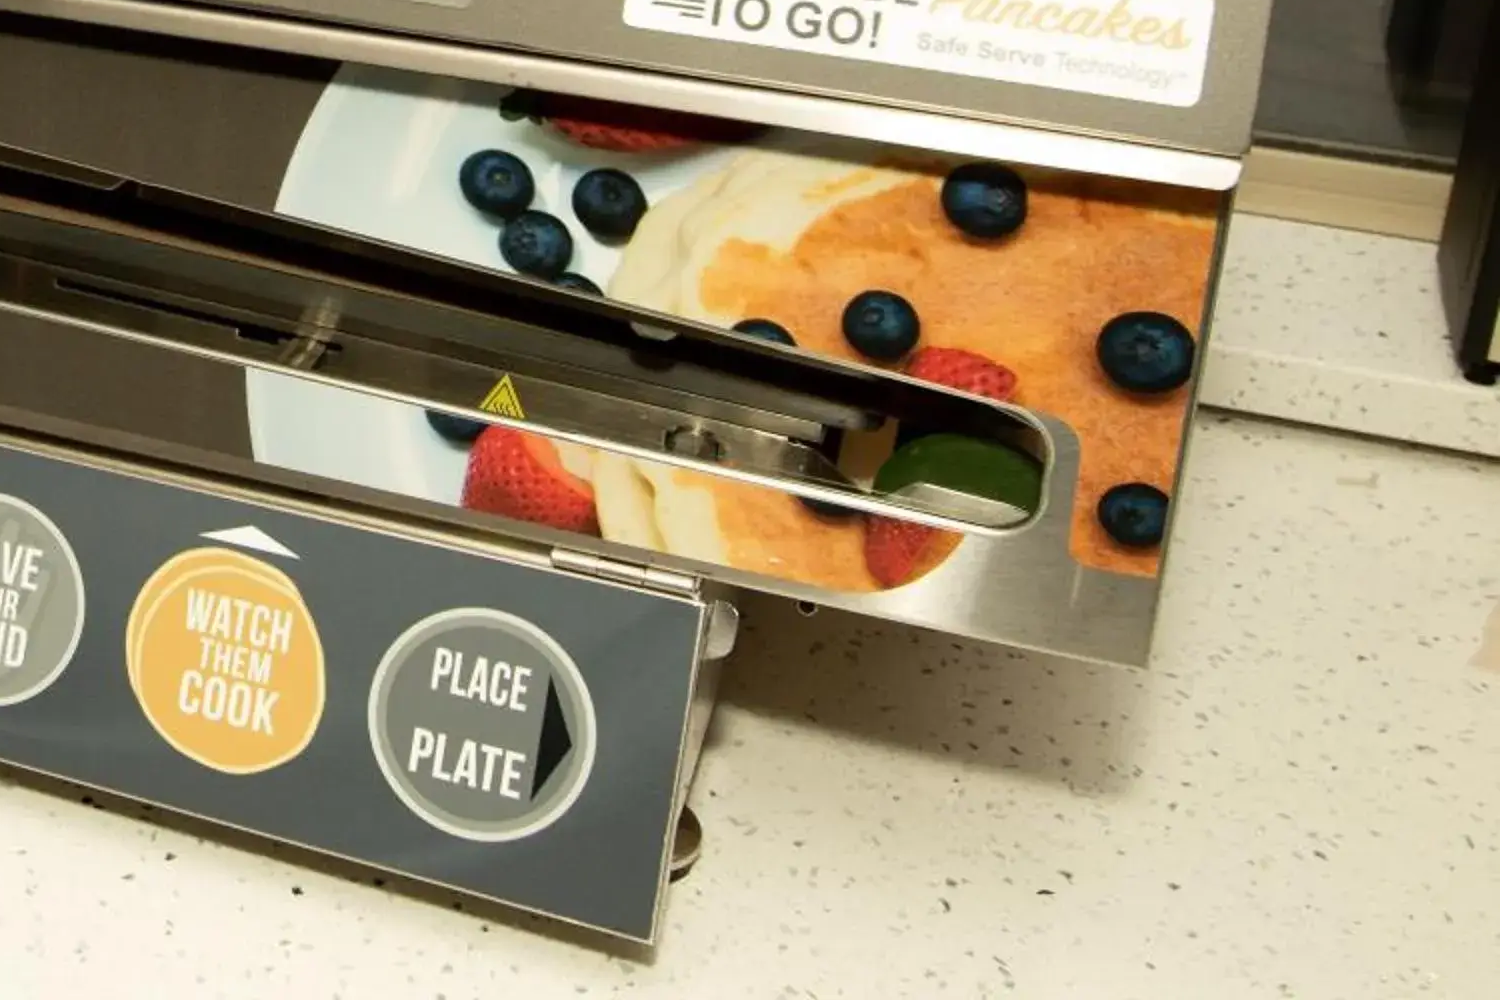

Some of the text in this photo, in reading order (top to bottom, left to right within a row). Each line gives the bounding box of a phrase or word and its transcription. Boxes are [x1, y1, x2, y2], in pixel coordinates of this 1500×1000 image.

[785, 1, 883, 49] GO!
[915, 31, 968, 56] Safe
[977, 40, 1046, 67] Serve
[184, 587, 295, 655] WATCH
[198, 635, 274, 687] THEM
[430, 646, 533, 712] PLACE
[177, 669, 281, 737] COOK
[407, 726, 527, 800] PLATE
